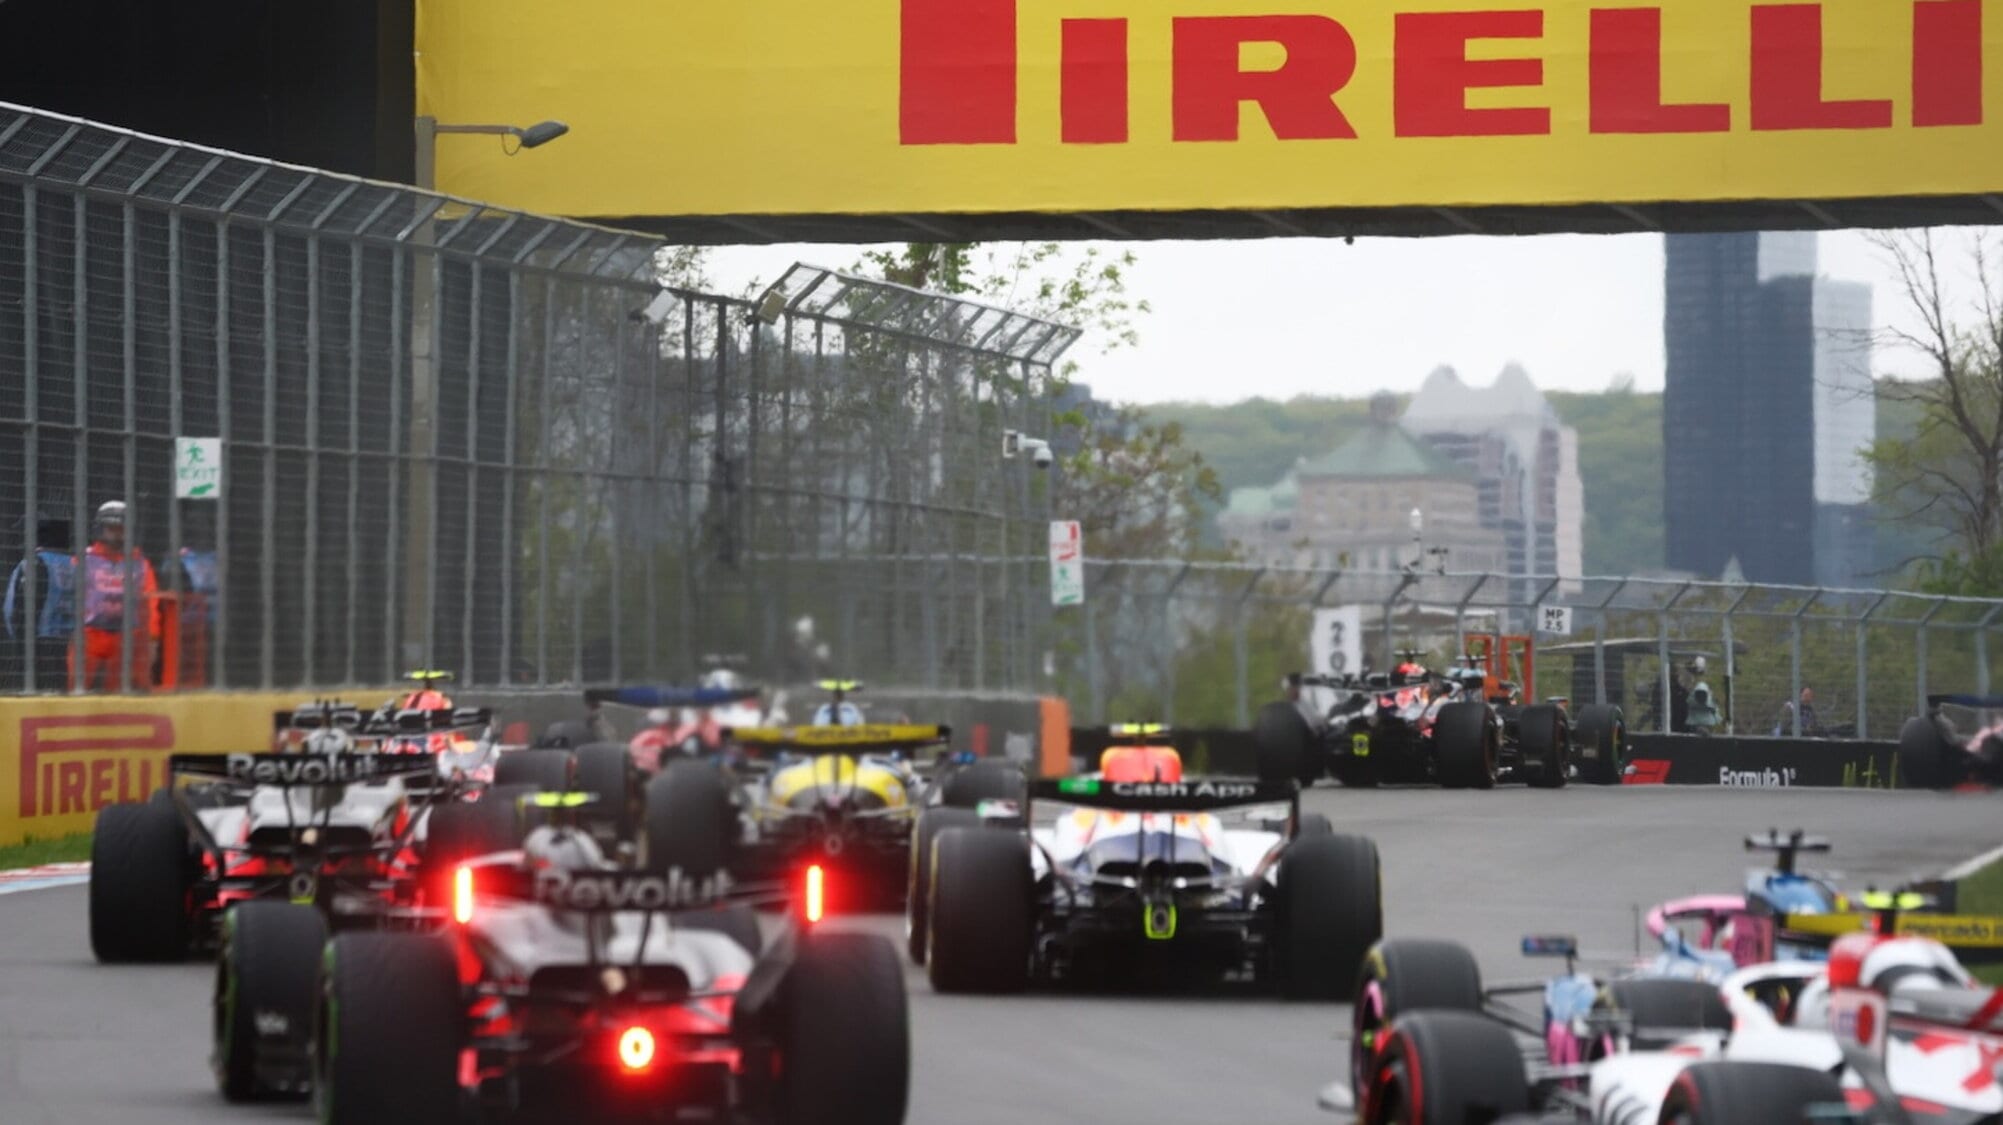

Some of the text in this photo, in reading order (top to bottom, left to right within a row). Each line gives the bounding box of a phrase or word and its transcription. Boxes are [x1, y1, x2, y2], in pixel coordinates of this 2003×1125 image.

[179, 466, 217, 480] EXIT
[1545, 608, 1564, 619] MP
[1545, 620, 1563, 632] 2.5
[227, 752, 377, 781] Revolut
[1719, 766, 1780, 787] Formula
[1112, 780, 1256, 799] Cash App
[535, 865, 738, 906] Revolut
